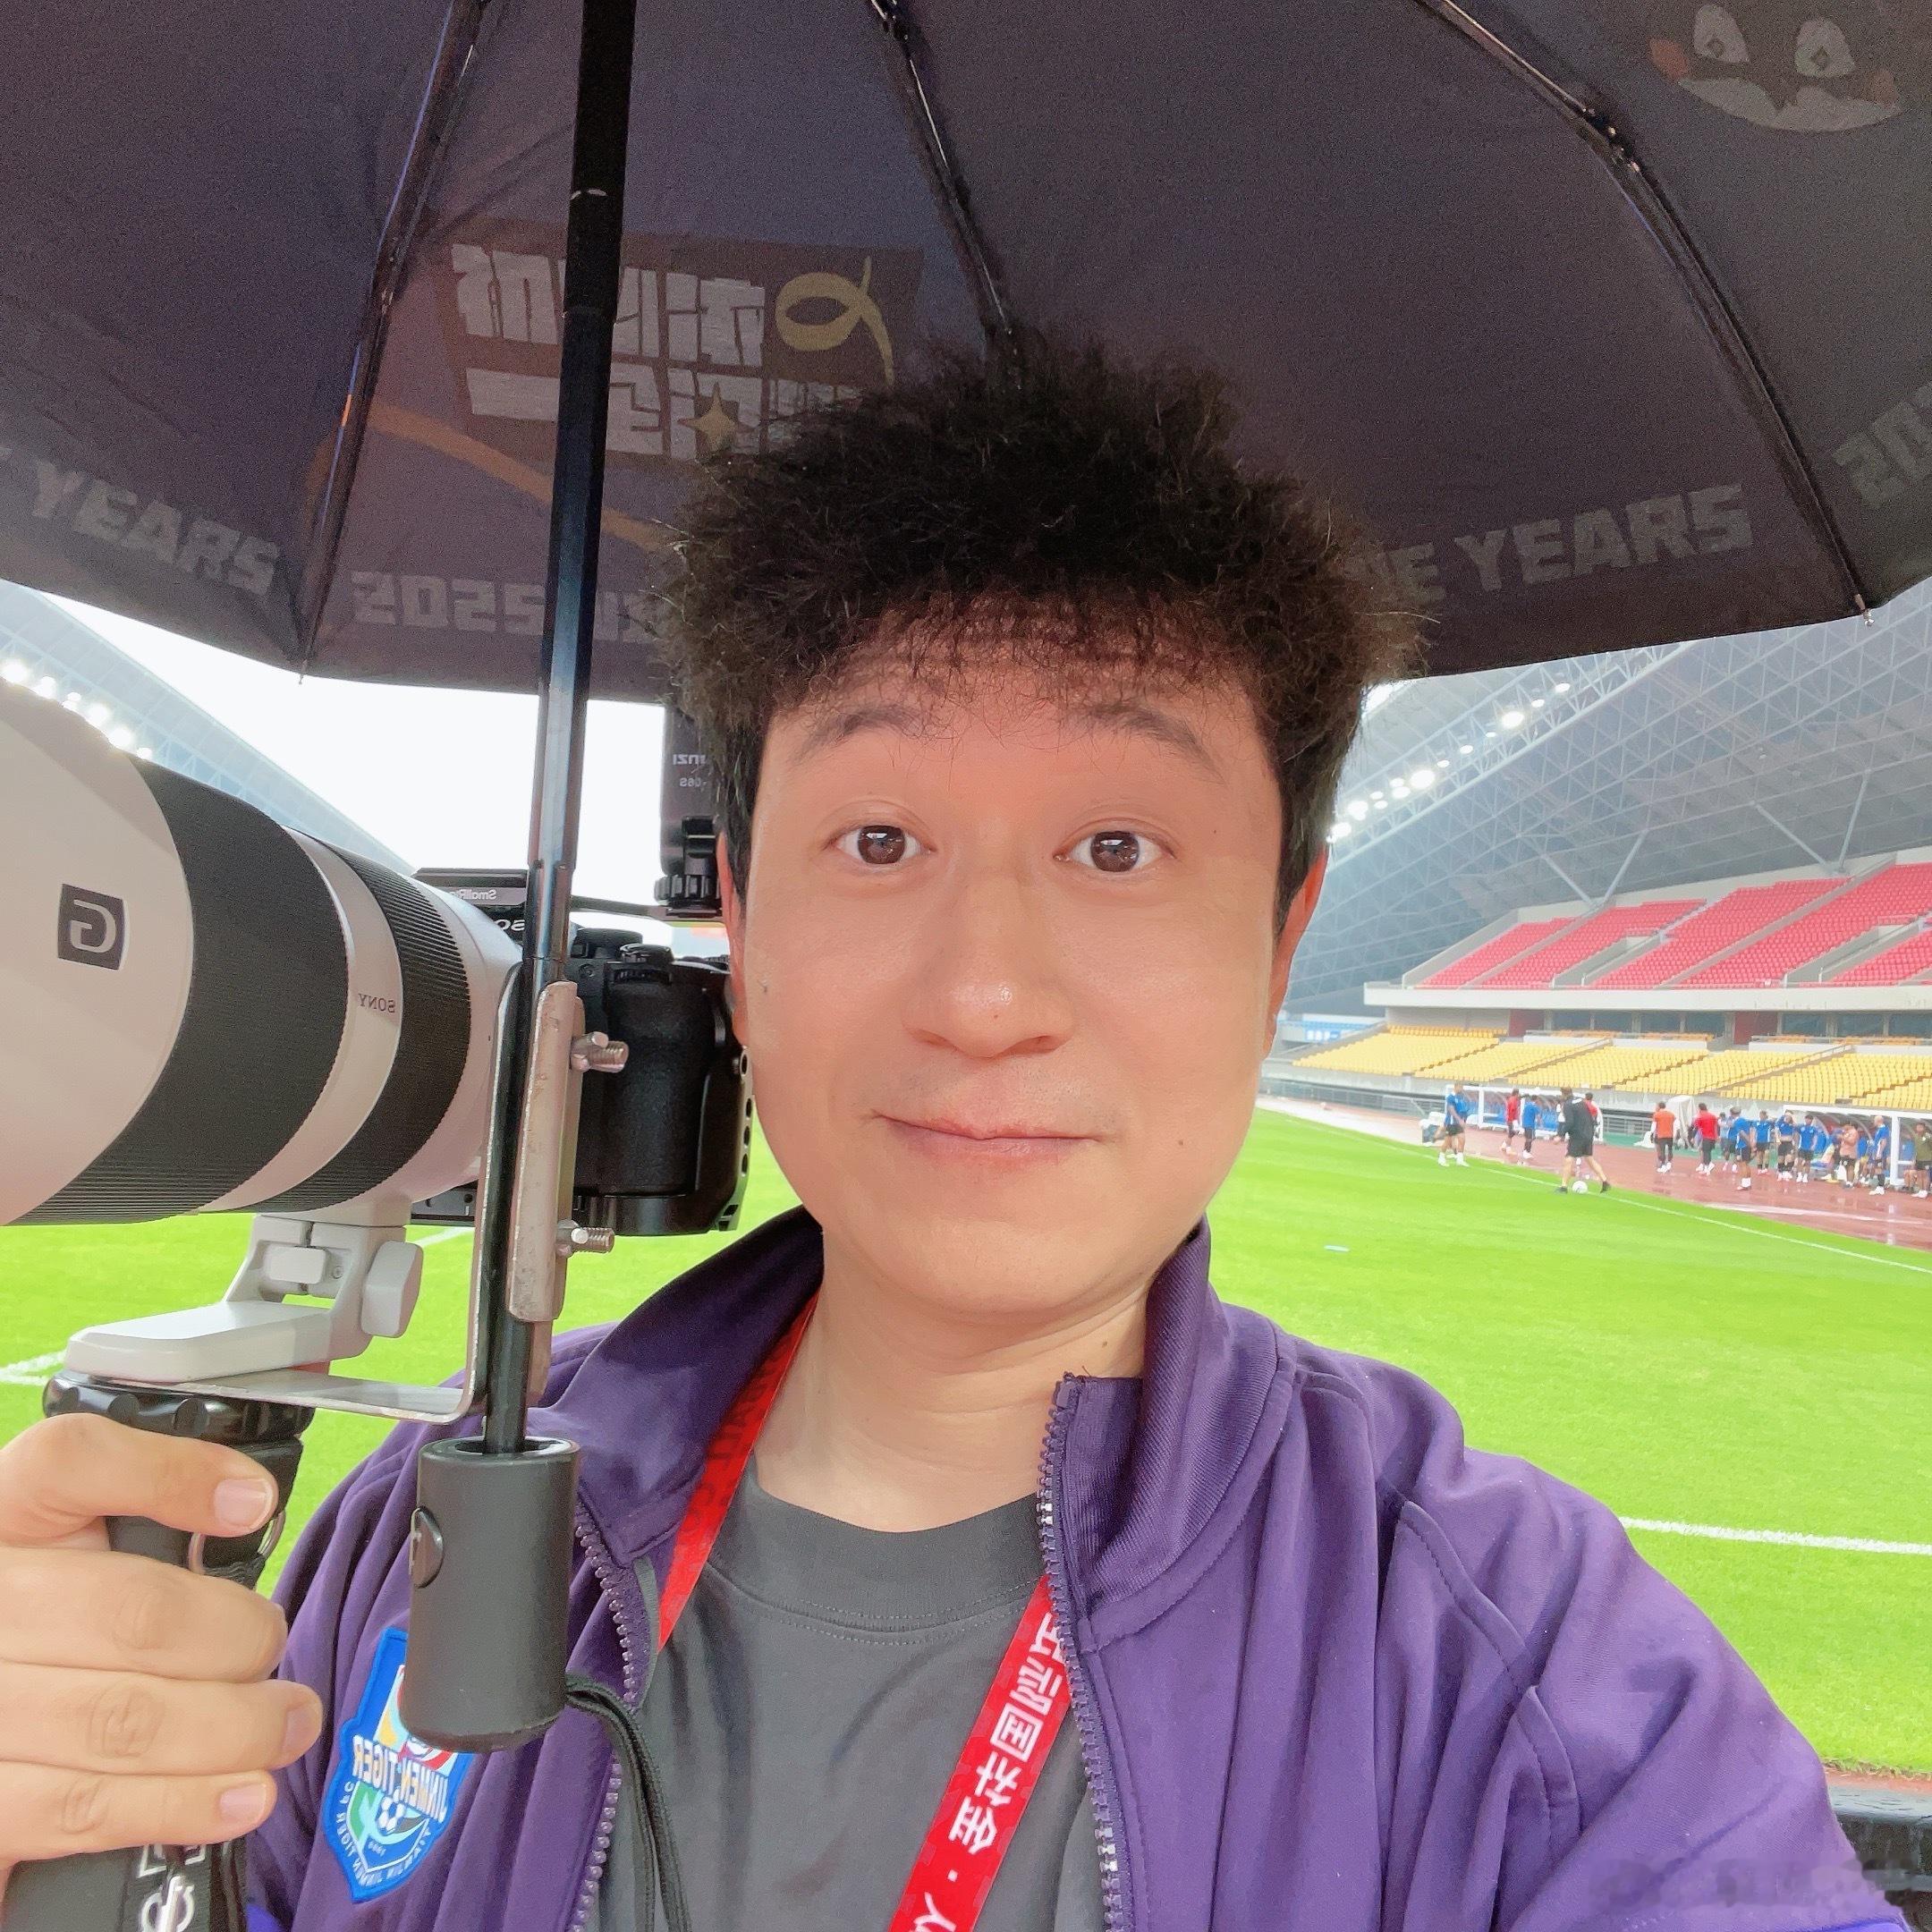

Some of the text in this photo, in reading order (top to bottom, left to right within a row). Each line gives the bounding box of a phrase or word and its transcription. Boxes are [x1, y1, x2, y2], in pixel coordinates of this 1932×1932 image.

[32, 459, 280, 596] YEARS
[1454, 483, 1754, 592] YEARS
[352, 570, 545, 637] 2025
